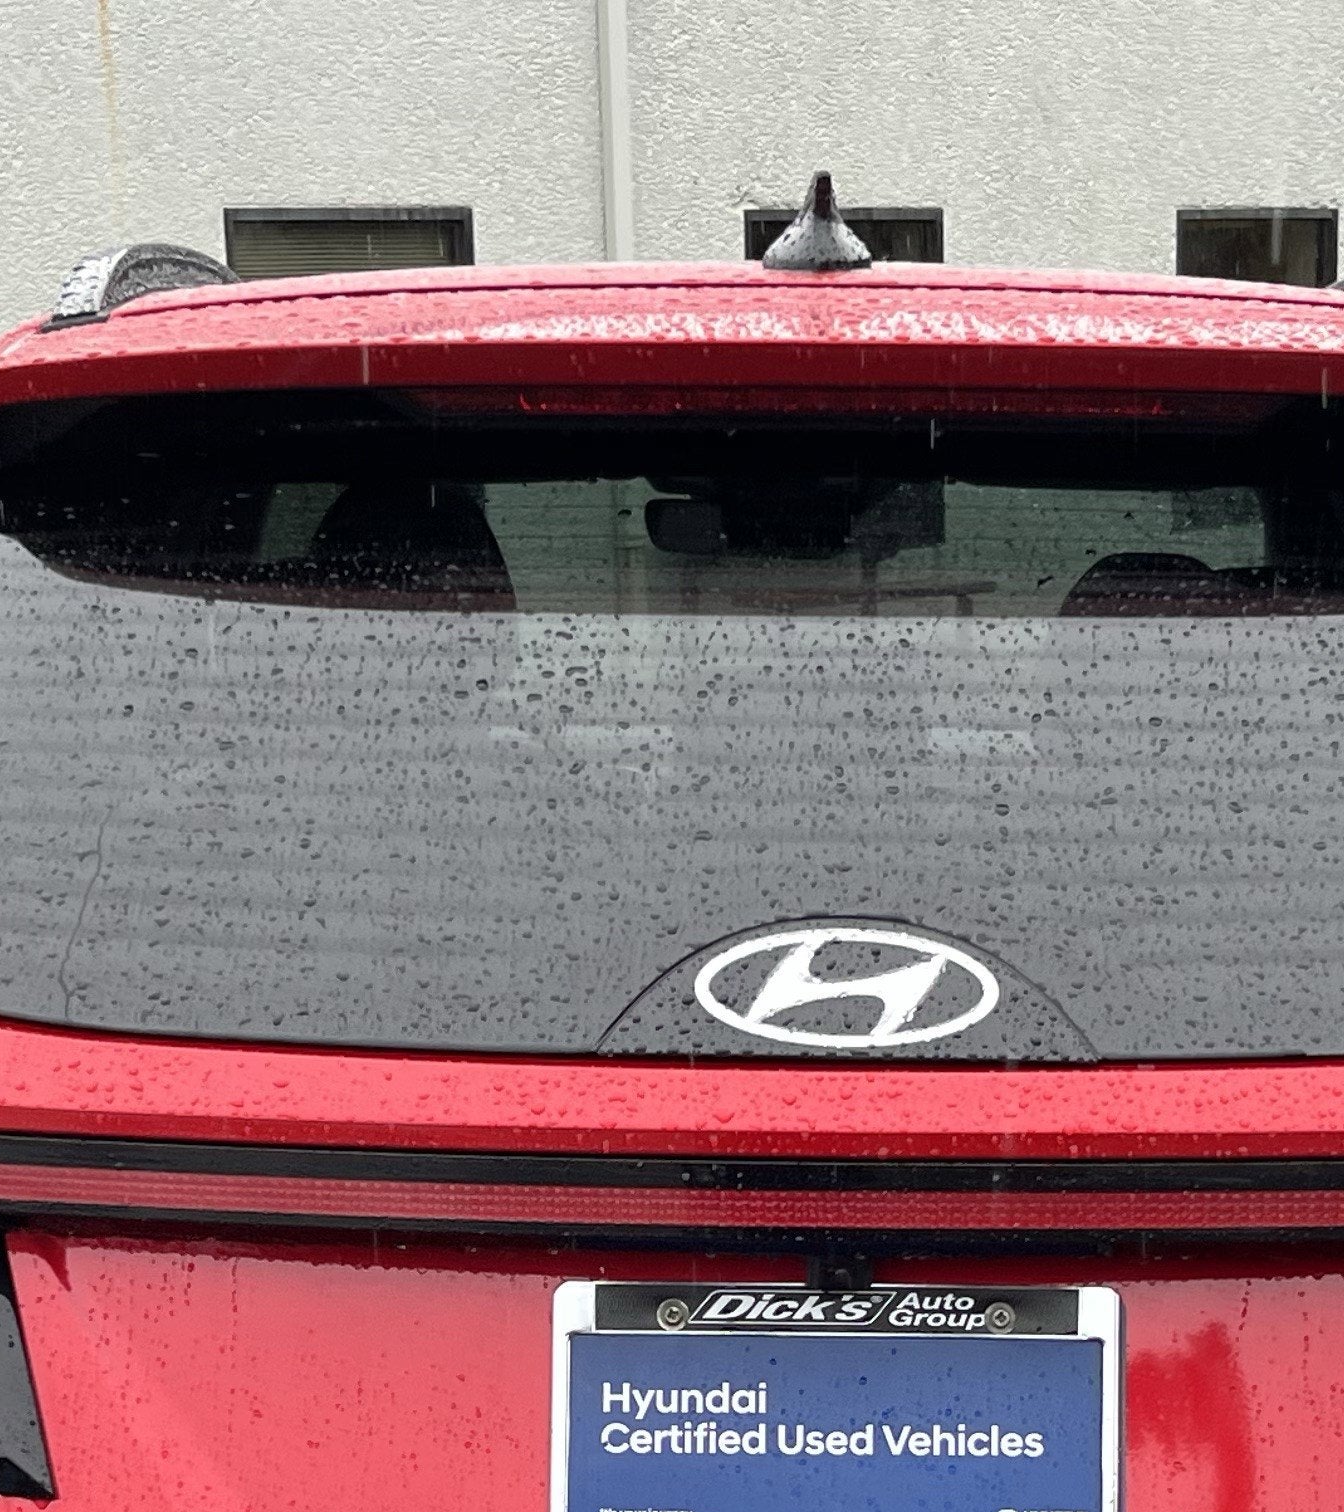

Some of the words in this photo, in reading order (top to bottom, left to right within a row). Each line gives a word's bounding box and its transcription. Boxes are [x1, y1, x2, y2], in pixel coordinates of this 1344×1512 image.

[702, 1293, 872, 1321] Dick's
[895, 1292, 975, 1311] Auto
[888, 1311, 986, 1331] Group
[601, 1382, 767, 1420] Hyundai
[601, 1422, 766, 1456] Certified
[777, 1425, 874, 1456] Used
[882, 1425, 1045, 1458] Vehicles
